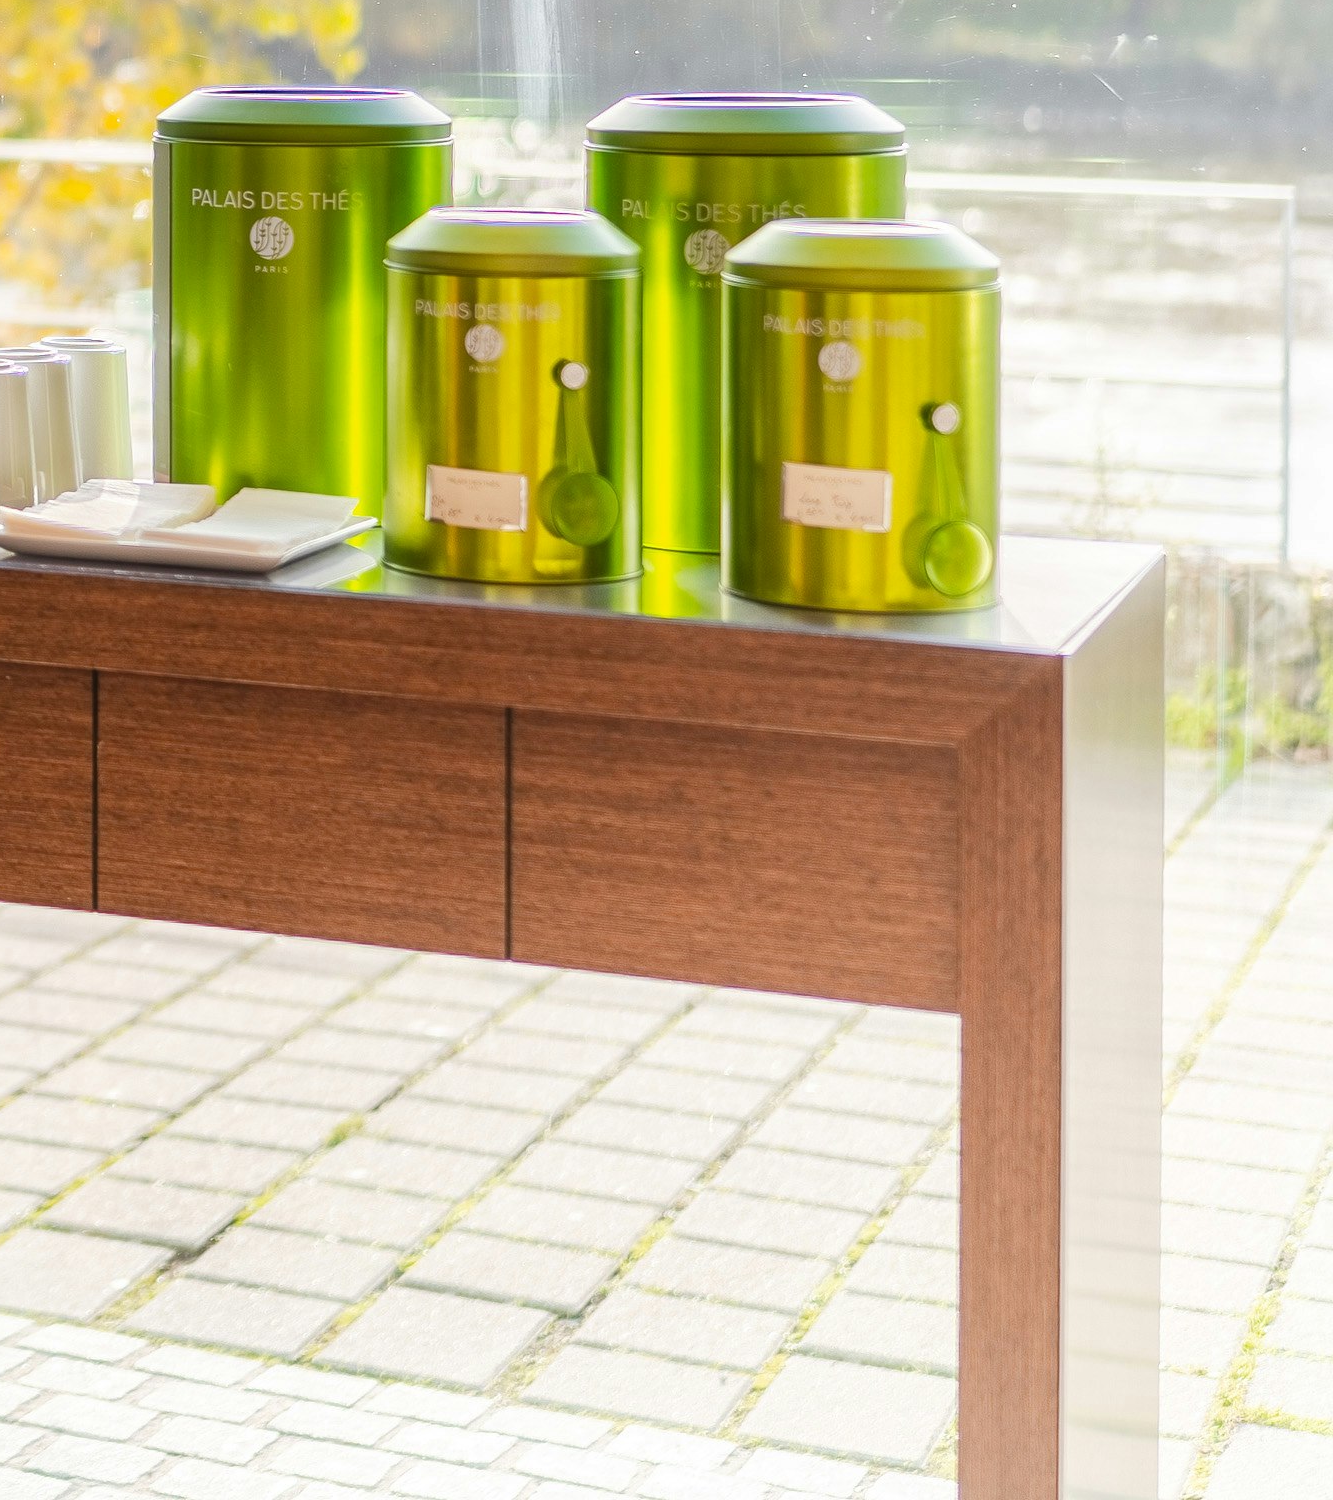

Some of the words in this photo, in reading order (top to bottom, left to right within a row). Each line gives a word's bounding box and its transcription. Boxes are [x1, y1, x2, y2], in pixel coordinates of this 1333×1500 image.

[191, 188, 256, 210] PALAIS
[260, 191, 304, 211] DES
[309, 189, 364, 211] THÉS
[621, 198, 691, 222] PALIS
[695, 203, 742, 223] DES
[254, 265, 289, 274] PARIS
[415, 299, 472, 321] PALAIS
[763, 314, 825, 337] PALAIS
